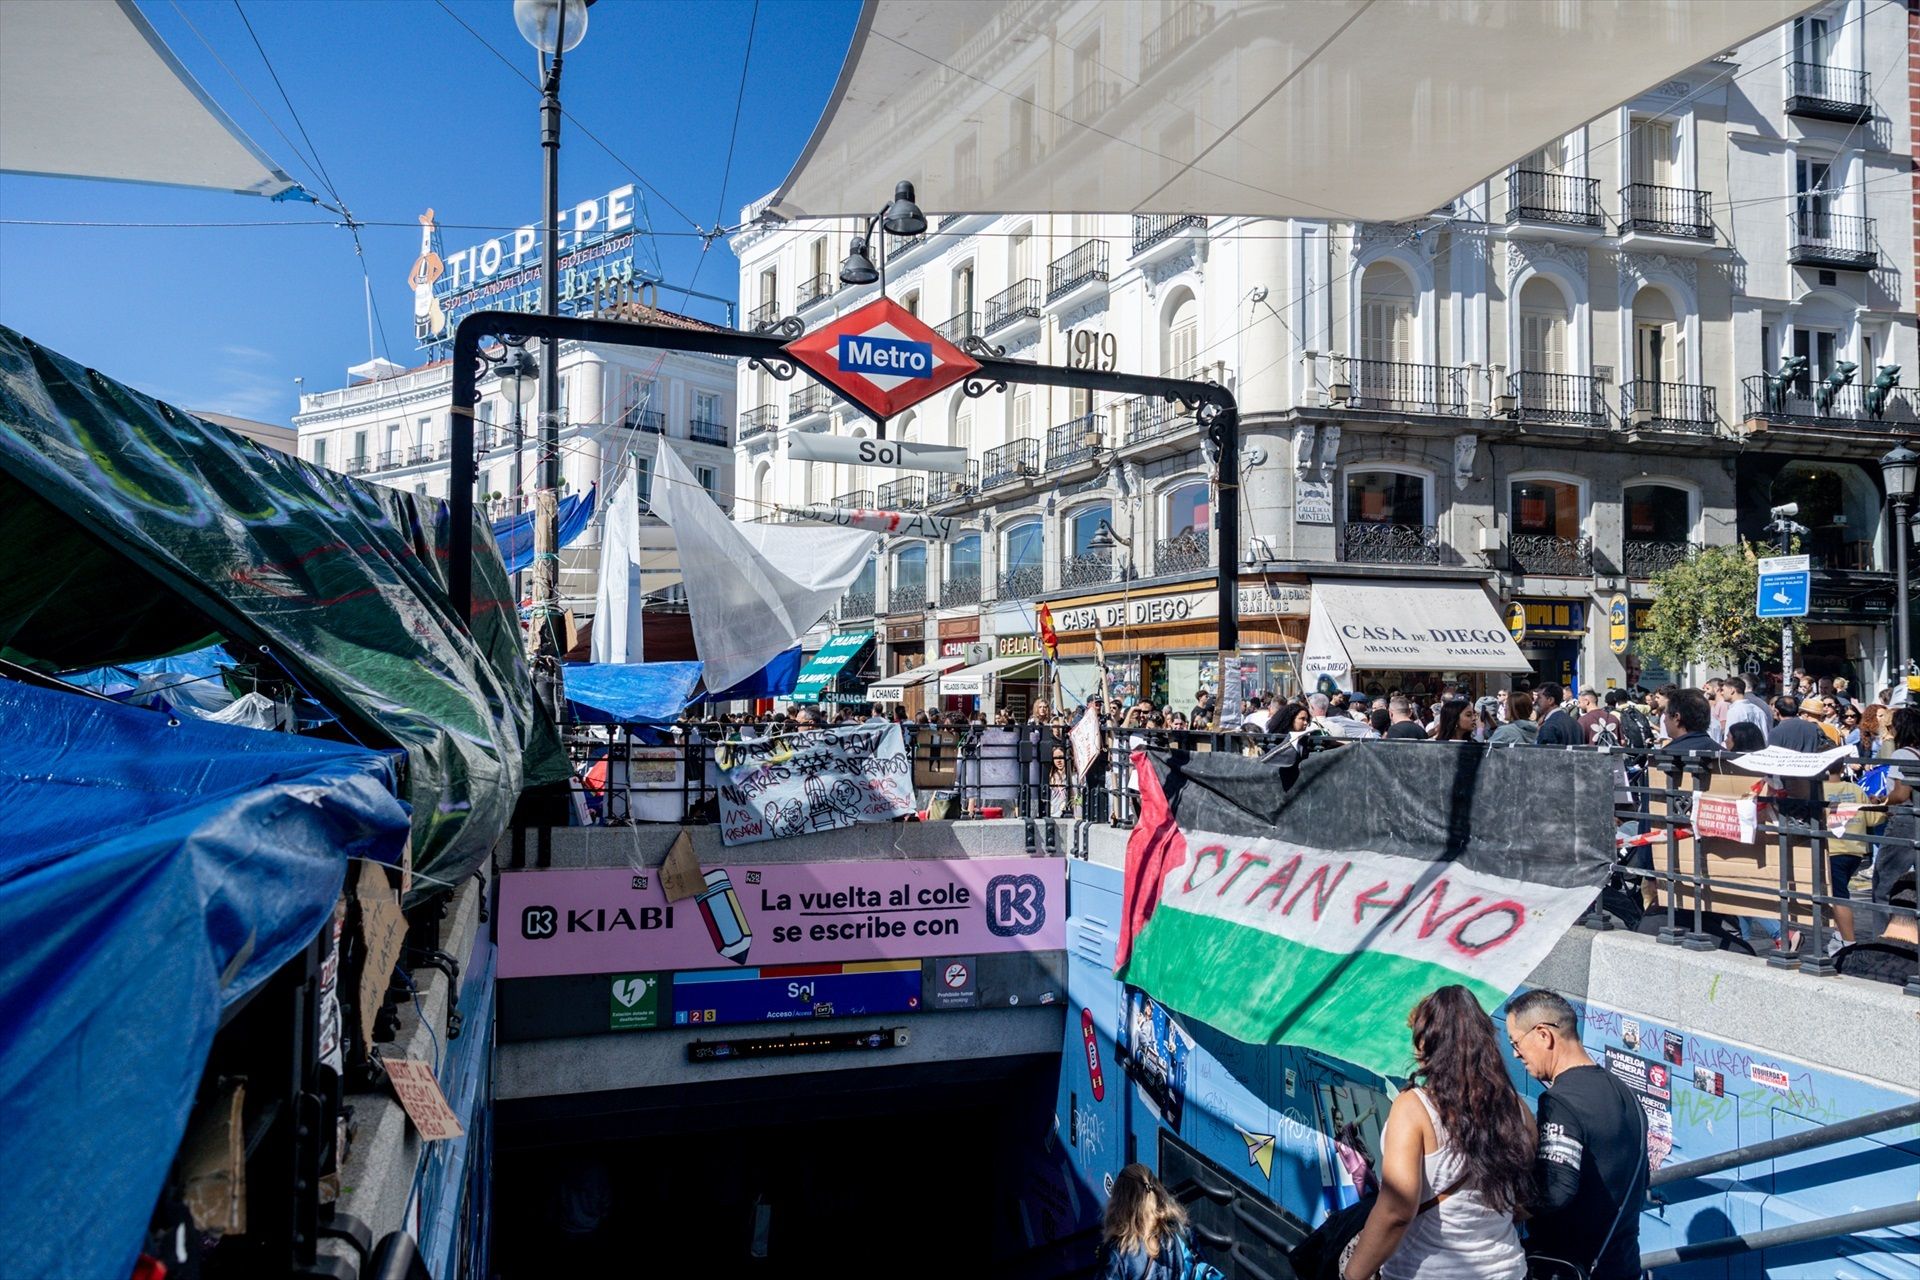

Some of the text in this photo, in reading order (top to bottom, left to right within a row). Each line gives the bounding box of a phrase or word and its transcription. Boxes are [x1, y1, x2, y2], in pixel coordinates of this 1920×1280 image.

[447, 238, 501, 289] TIO
[444, 295, 461, 311] SOL
[467, 289, 480, 304] DE
[847, 340, 927, 371] Metro
[1065, 329, 1118, 372] 1919
[858, 440, 902, 466] Sol
[1298, 512, 1332, 522] MONTERA
[1062, 597, 1190, 631] CASA DE DIEGO
[1342, 625, 1508, 644] CASA DE DIEGO
[1363, 645, 1507, 657] ABANICOS PARAGUAS
[1327, 662, 1349, 673] DIEGO
[875, 688, 900, 700] CHANGE
[761, 882, 971, 912] La vuelta al cole
[1182, 843, 1526, 958] OTAN NO
[566, 905, 674, 933] KIABI
[771, 915, 960, 944] se escribe con
[787, 981, 815, 999] Sol
[1612, 1060, 1647, 1078] GENERAL
[1617, 1052, 1646, 1069] HUELGA
[1752, 1066, 1782, 1080] IZQUIERDA
